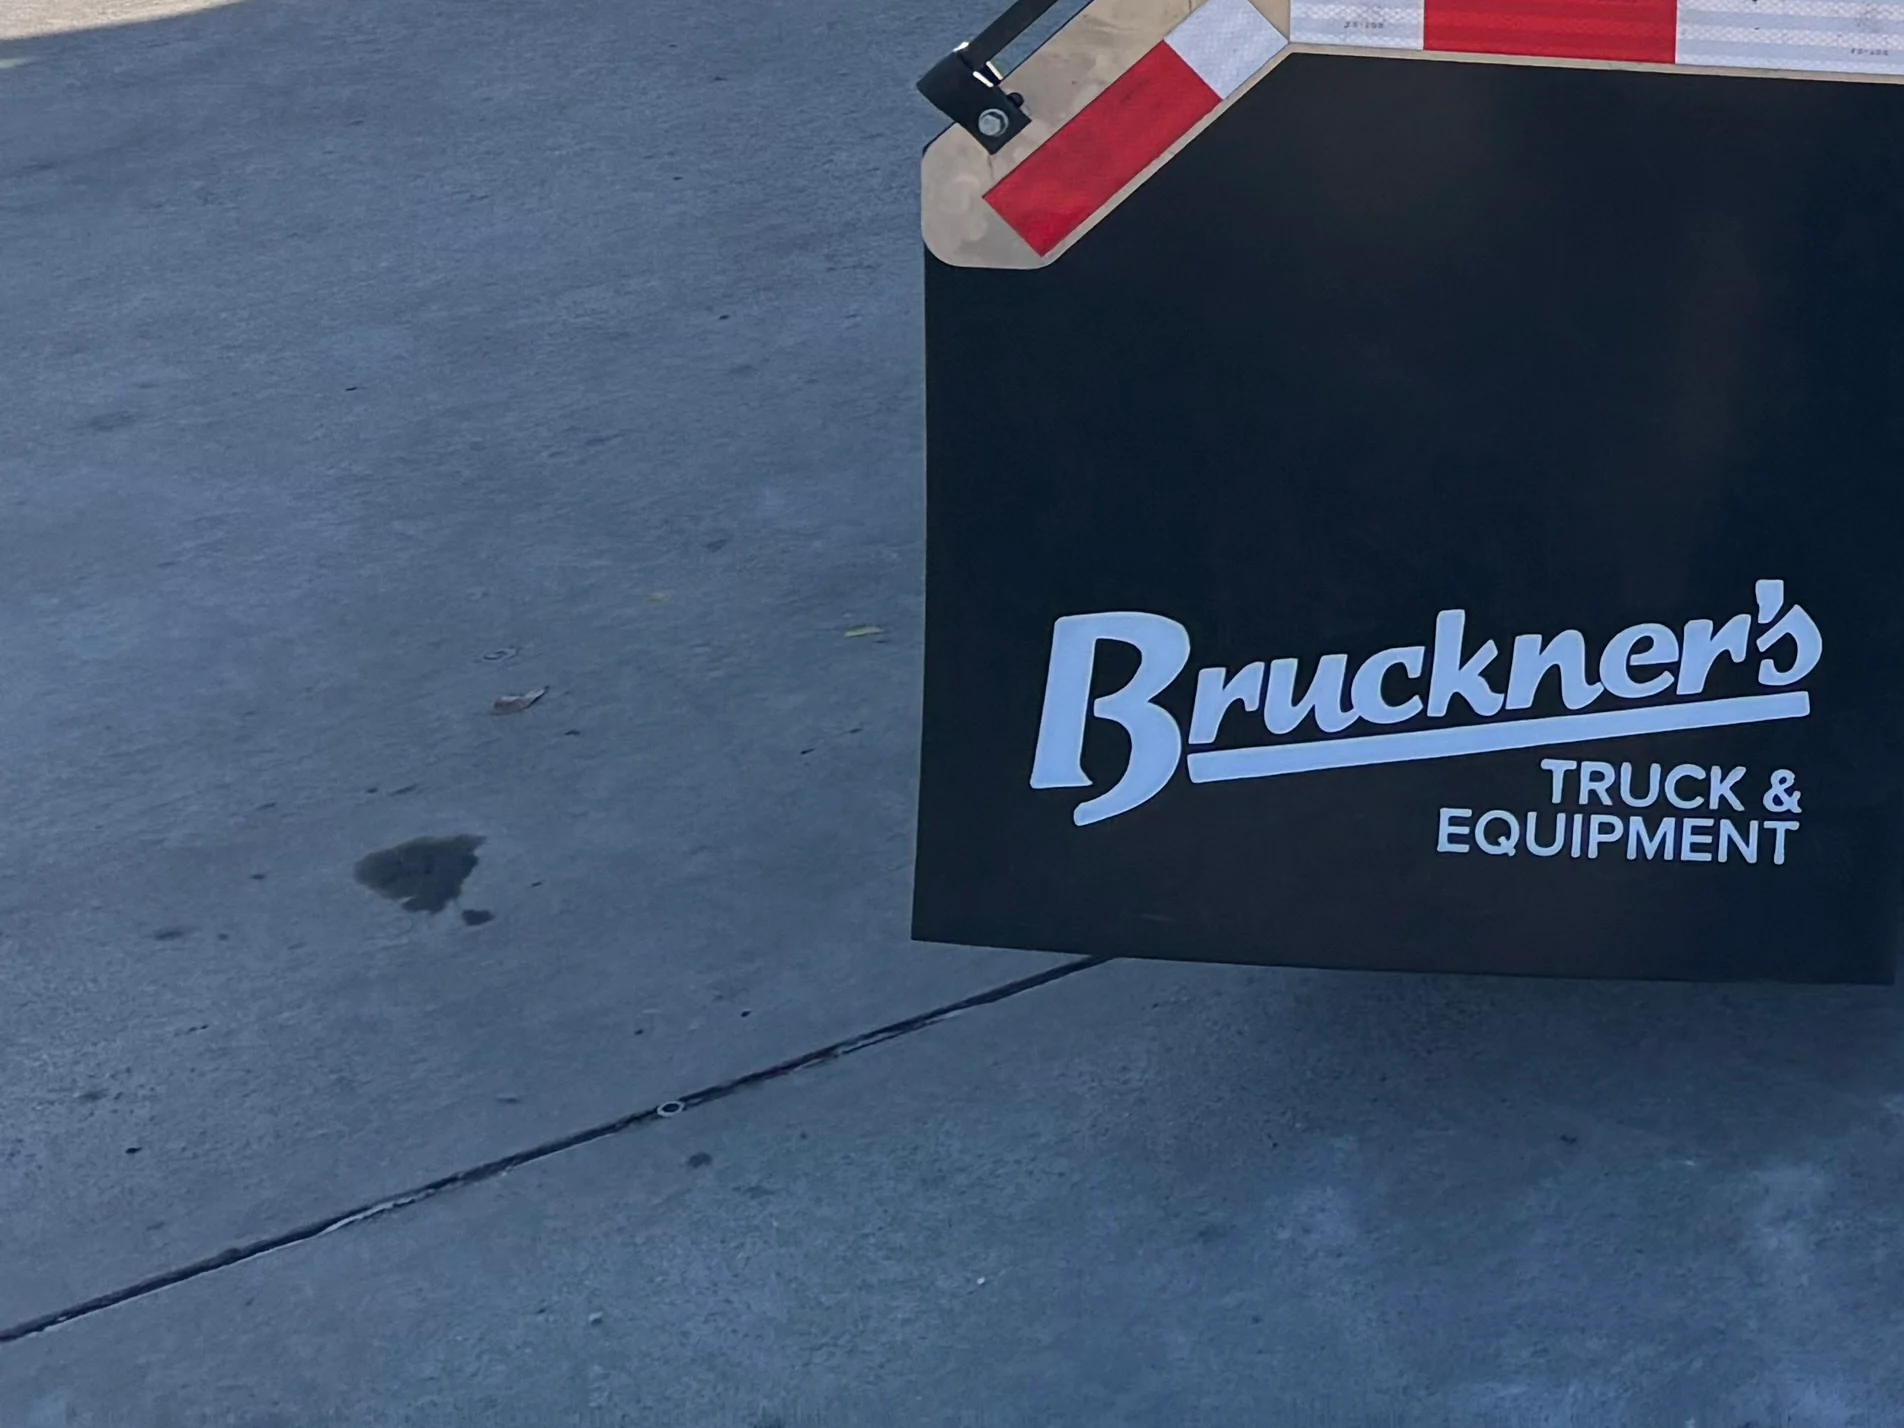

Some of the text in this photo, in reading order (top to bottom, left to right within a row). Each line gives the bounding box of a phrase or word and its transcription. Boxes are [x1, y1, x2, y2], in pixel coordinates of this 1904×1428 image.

[1030, 580, 1822, 826] Bruckner's
[1541, 759, 1801, 813] TRUCK &
[1437, 808, 1799, 864] EQUIPMENT
